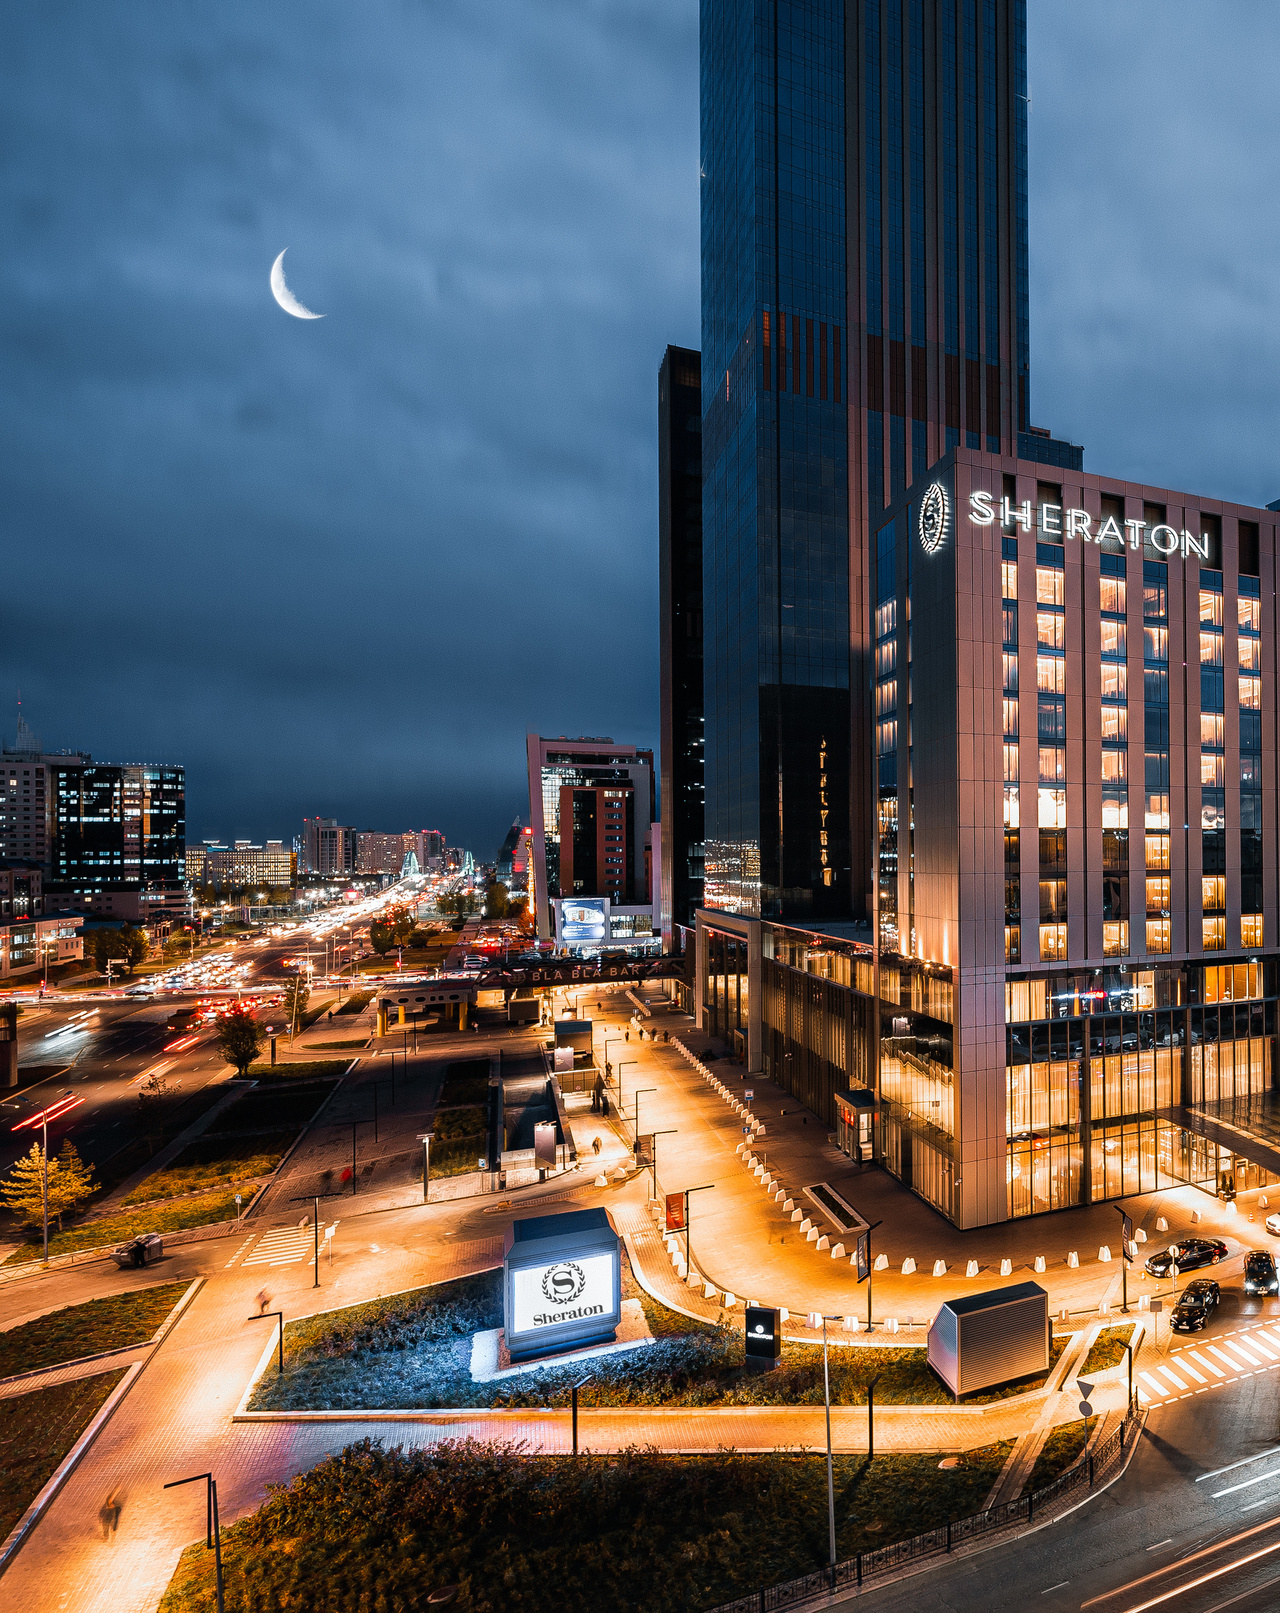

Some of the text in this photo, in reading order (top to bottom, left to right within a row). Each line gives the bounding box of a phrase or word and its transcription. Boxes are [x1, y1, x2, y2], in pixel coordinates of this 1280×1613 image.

[969, 490, 1209, 560] SHERATON
[533, 970, 563, 981] BLA
[572, 968, 601, 979] BLA
[610, 966, 640, 977] BAR
[552, 1270, 575, 1295] S
[533, 1303, 604, 1326] Sheraton
